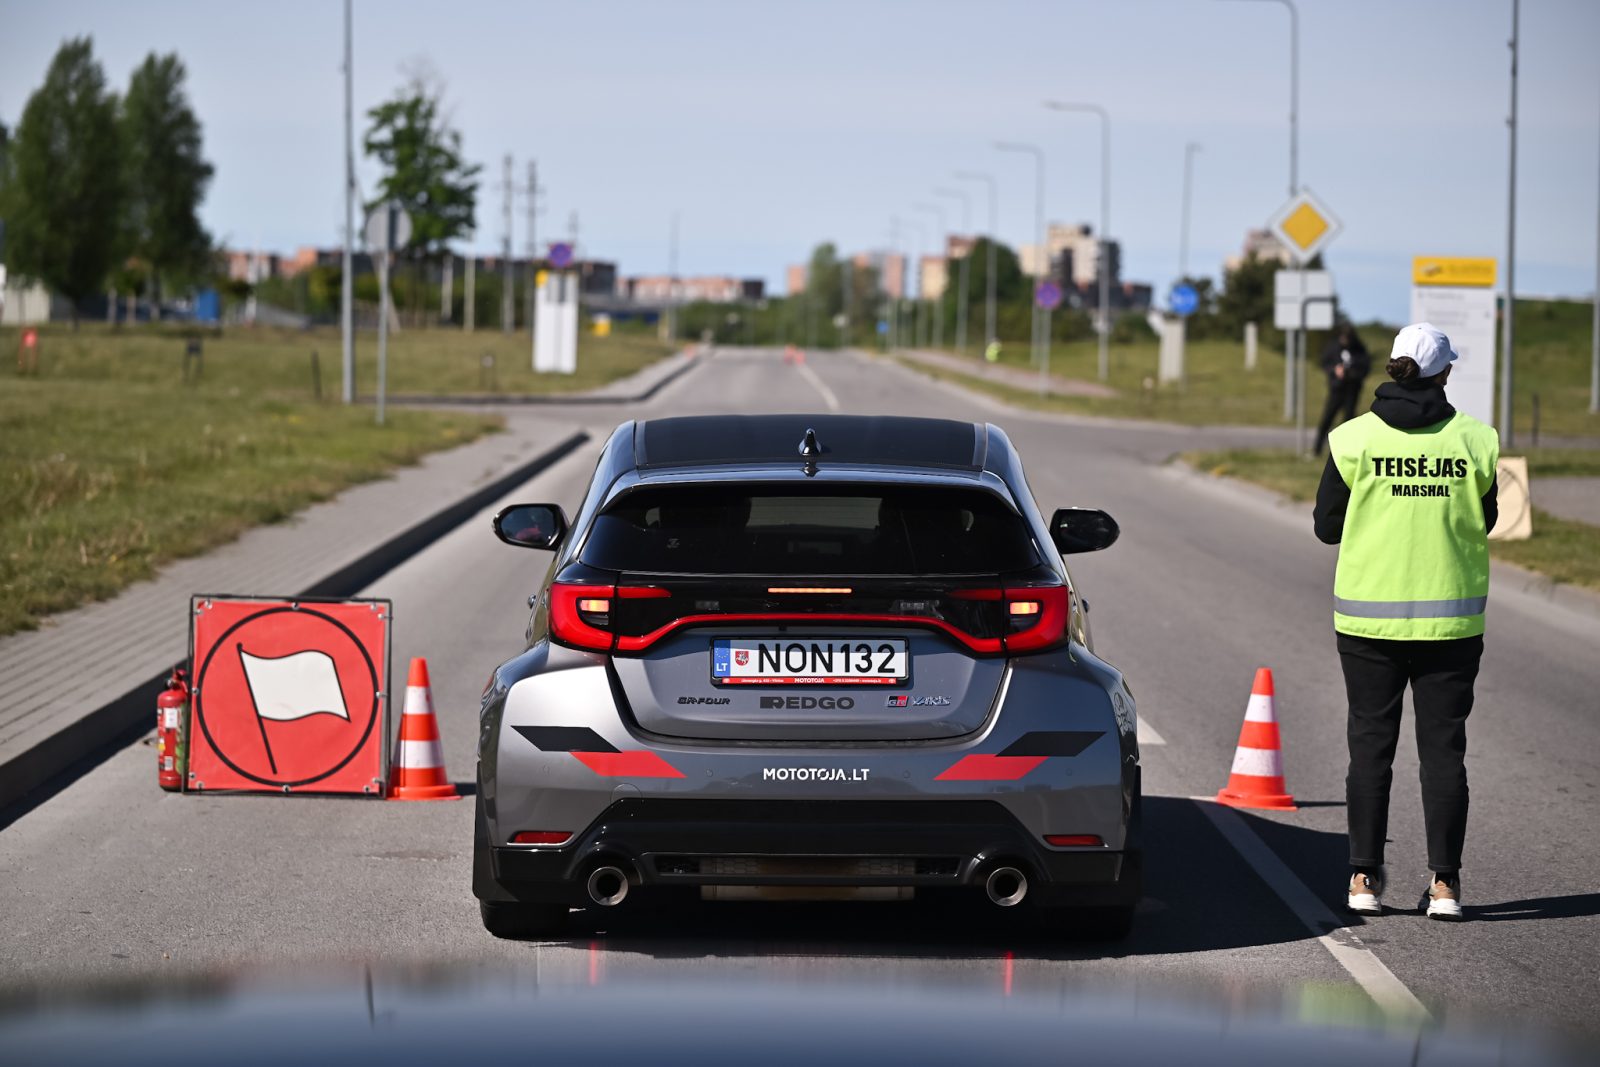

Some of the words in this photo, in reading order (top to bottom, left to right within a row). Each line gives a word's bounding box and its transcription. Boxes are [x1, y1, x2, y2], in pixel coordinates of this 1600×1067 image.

[1371, 454, 1468, 478] TEISĖJAS
[1392, 484, 1450, 497] MARSHAL
[716, 663, 728, 671] LT
[760, 696, 855, 710] REDGO
[887, 698, 908, 707] GR
[763, 768, 870, 781] MOTOTOJA.LT
